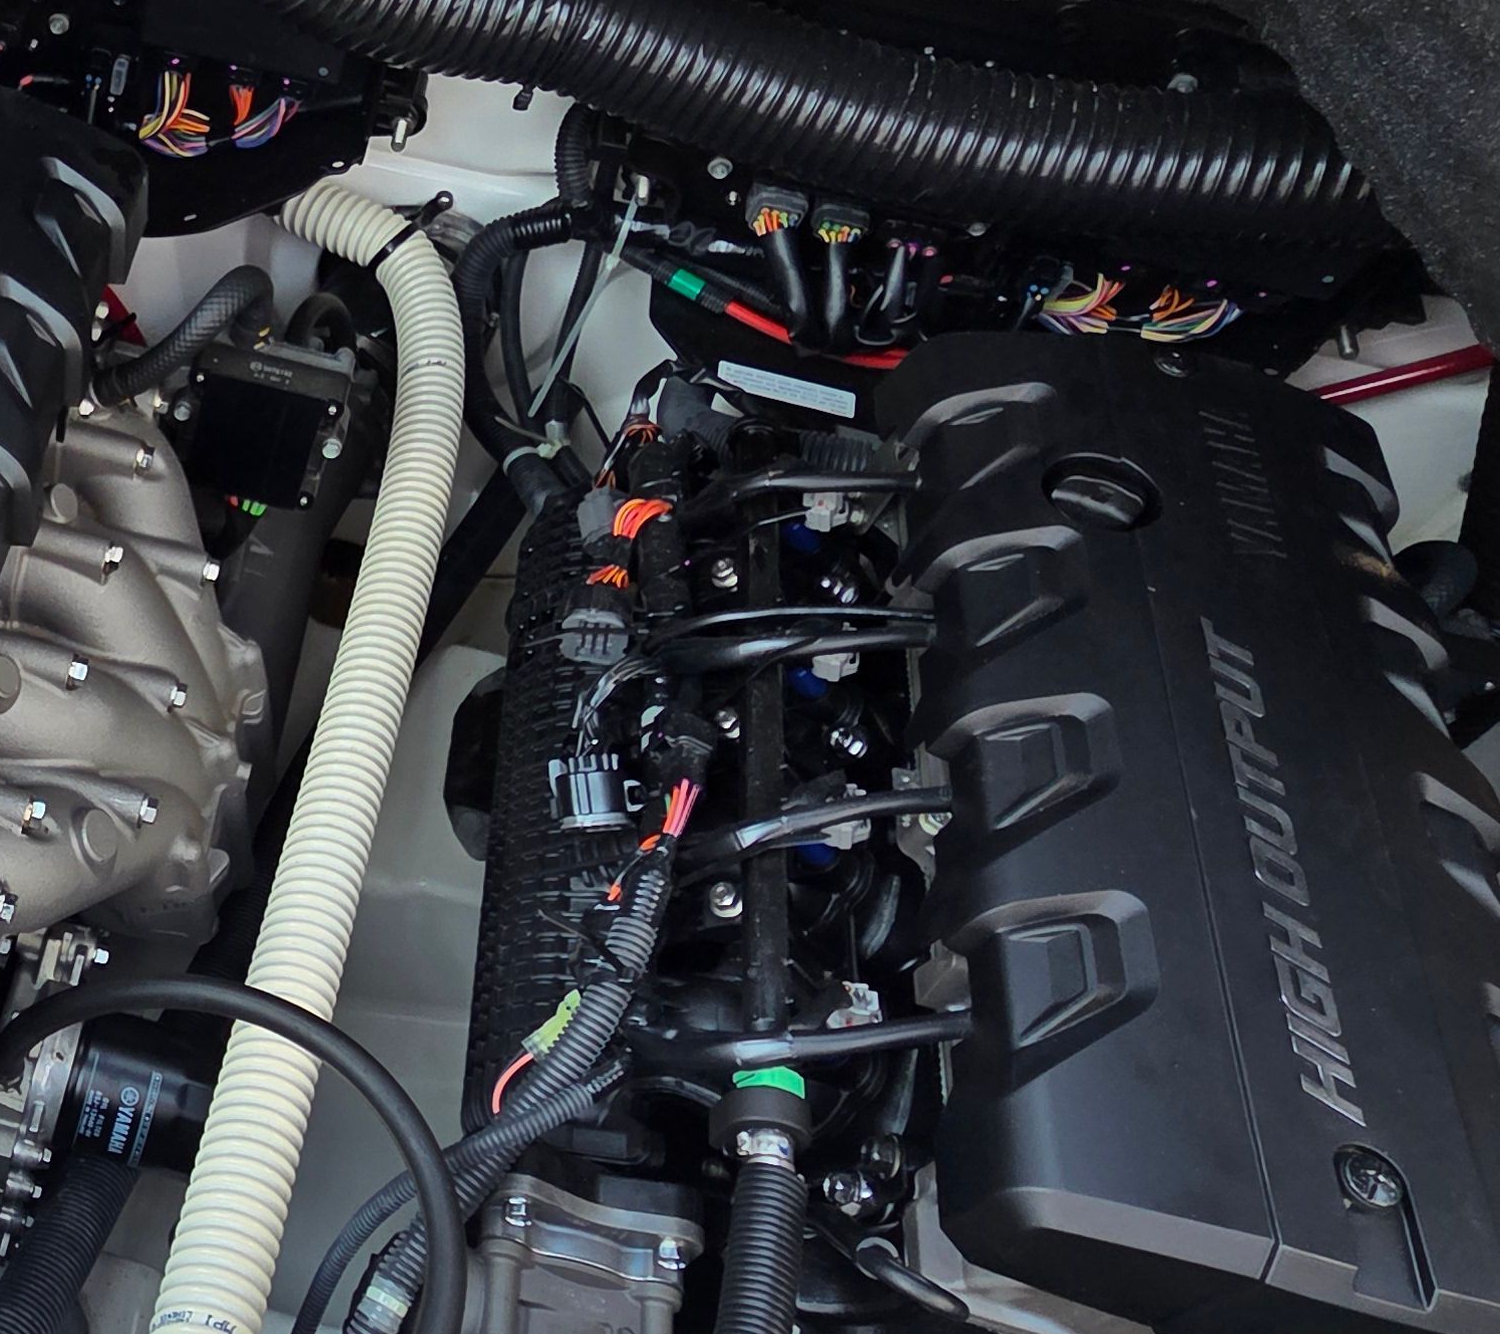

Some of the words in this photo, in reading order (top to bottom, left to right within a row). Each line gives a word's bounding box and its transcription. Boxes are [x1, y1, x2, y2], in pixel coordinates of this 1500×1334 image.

[1199, 615, 1311, 908] OUTPUT
[1262, 900, 1368, 1128] HIGH
[107, 1106, 136, 1155] YAMAHA
